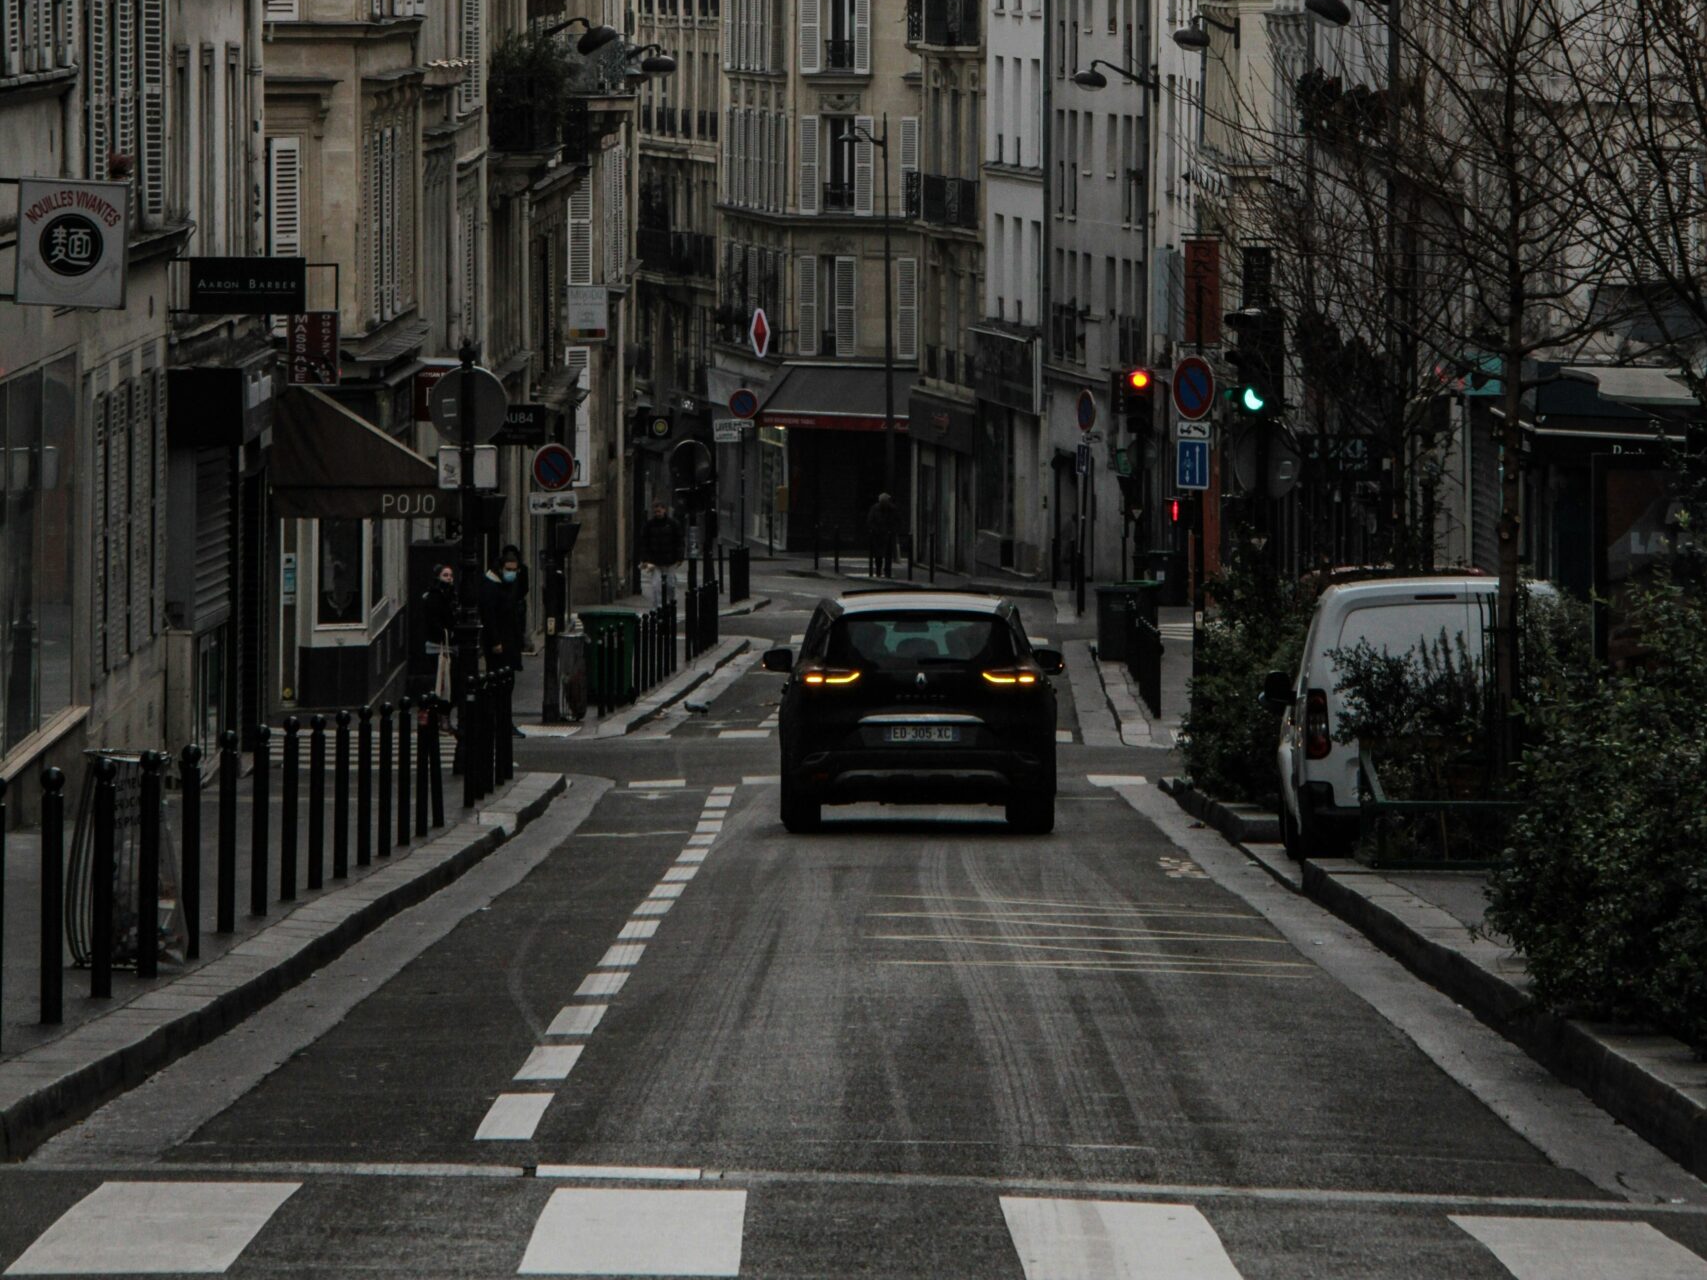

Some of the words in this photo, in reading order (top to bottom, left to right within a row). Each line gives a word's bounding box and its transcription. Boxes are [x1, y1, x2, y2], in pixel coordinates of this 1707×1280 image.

[24, 190, 74, 224] NOUILLES
[76, 191, 121, 228] VIVANTES
[294, 313, 309, 383] MASSAGE
[382, 493, 436, 514] POJO
